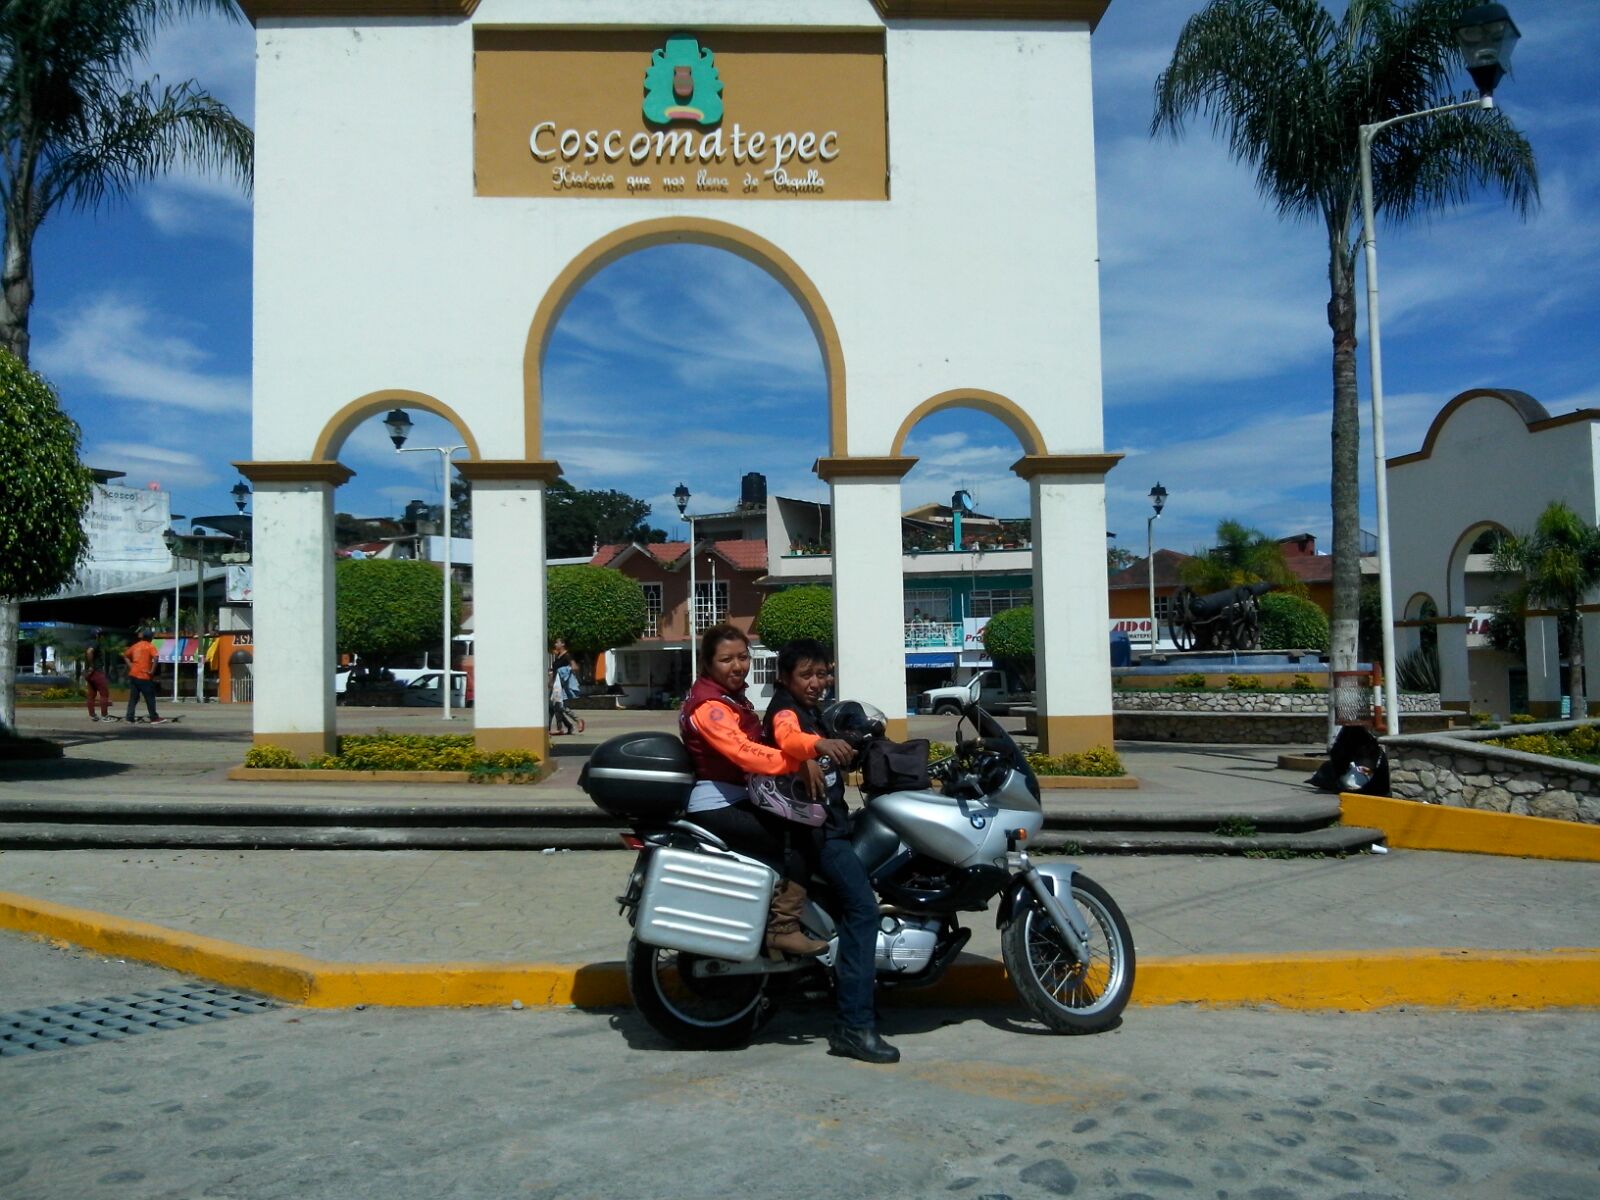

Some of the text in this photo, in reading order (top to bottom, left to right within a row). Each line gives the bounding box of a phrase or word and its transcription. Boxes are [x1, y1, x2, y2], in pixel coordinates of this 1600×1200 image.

[529, 122, 840, 177] Coscomatepec
[552, 166, 825, 188] Historia que nos llena de Orgullo
[1112, 620, 1153, 632] ADO
